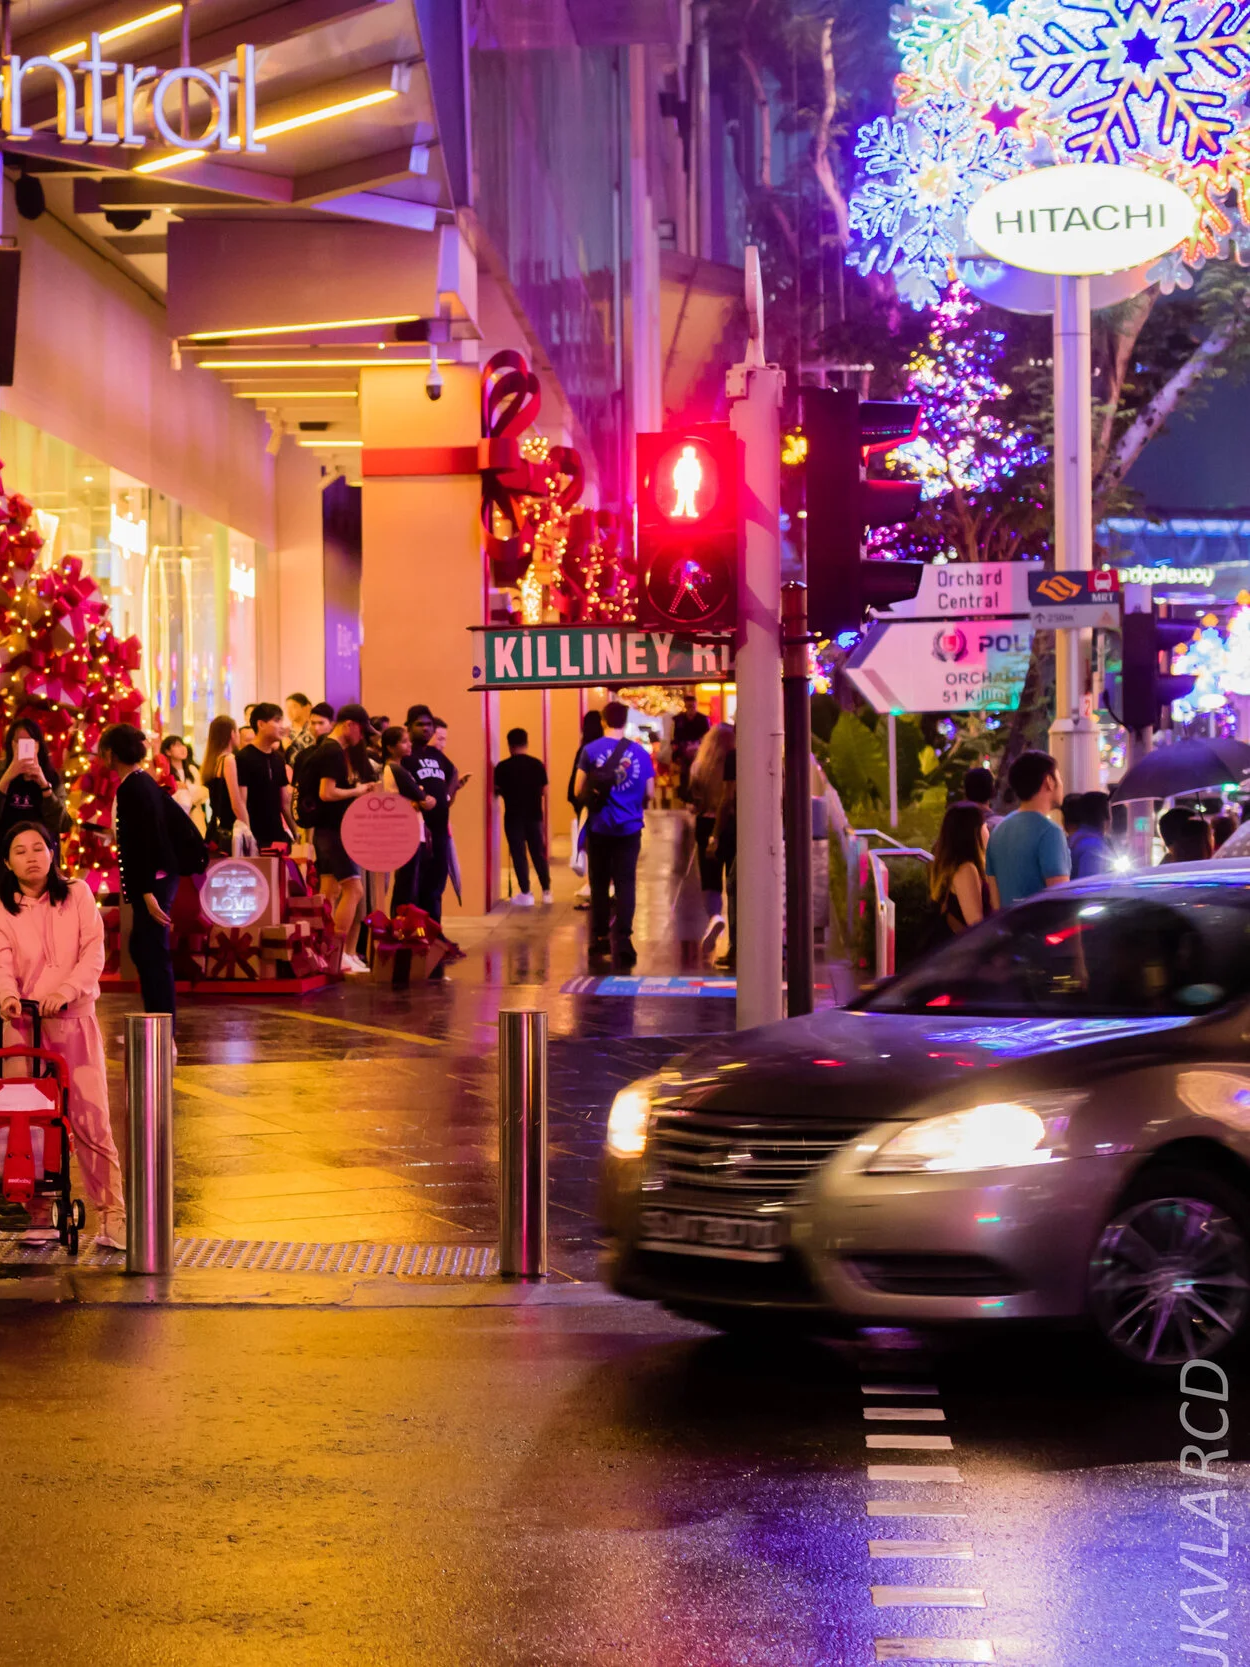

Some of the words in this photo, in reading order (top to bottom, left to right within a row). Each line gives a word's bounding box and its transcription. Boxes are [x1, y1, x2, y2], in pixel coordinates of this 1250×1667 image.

[995, 204, 1165, 234] HITACHI
[937, 569, 1003, 587] Orchard
[937, 592, 999, 610] Central
[1091, 592, 1114, 602] MRT
[494, 632, 674, 678] KILLINEY
[943, 690, 958, 703] 51
[367, 797, 396, 812] OC
[211, 896, 257, 912] LOVE
